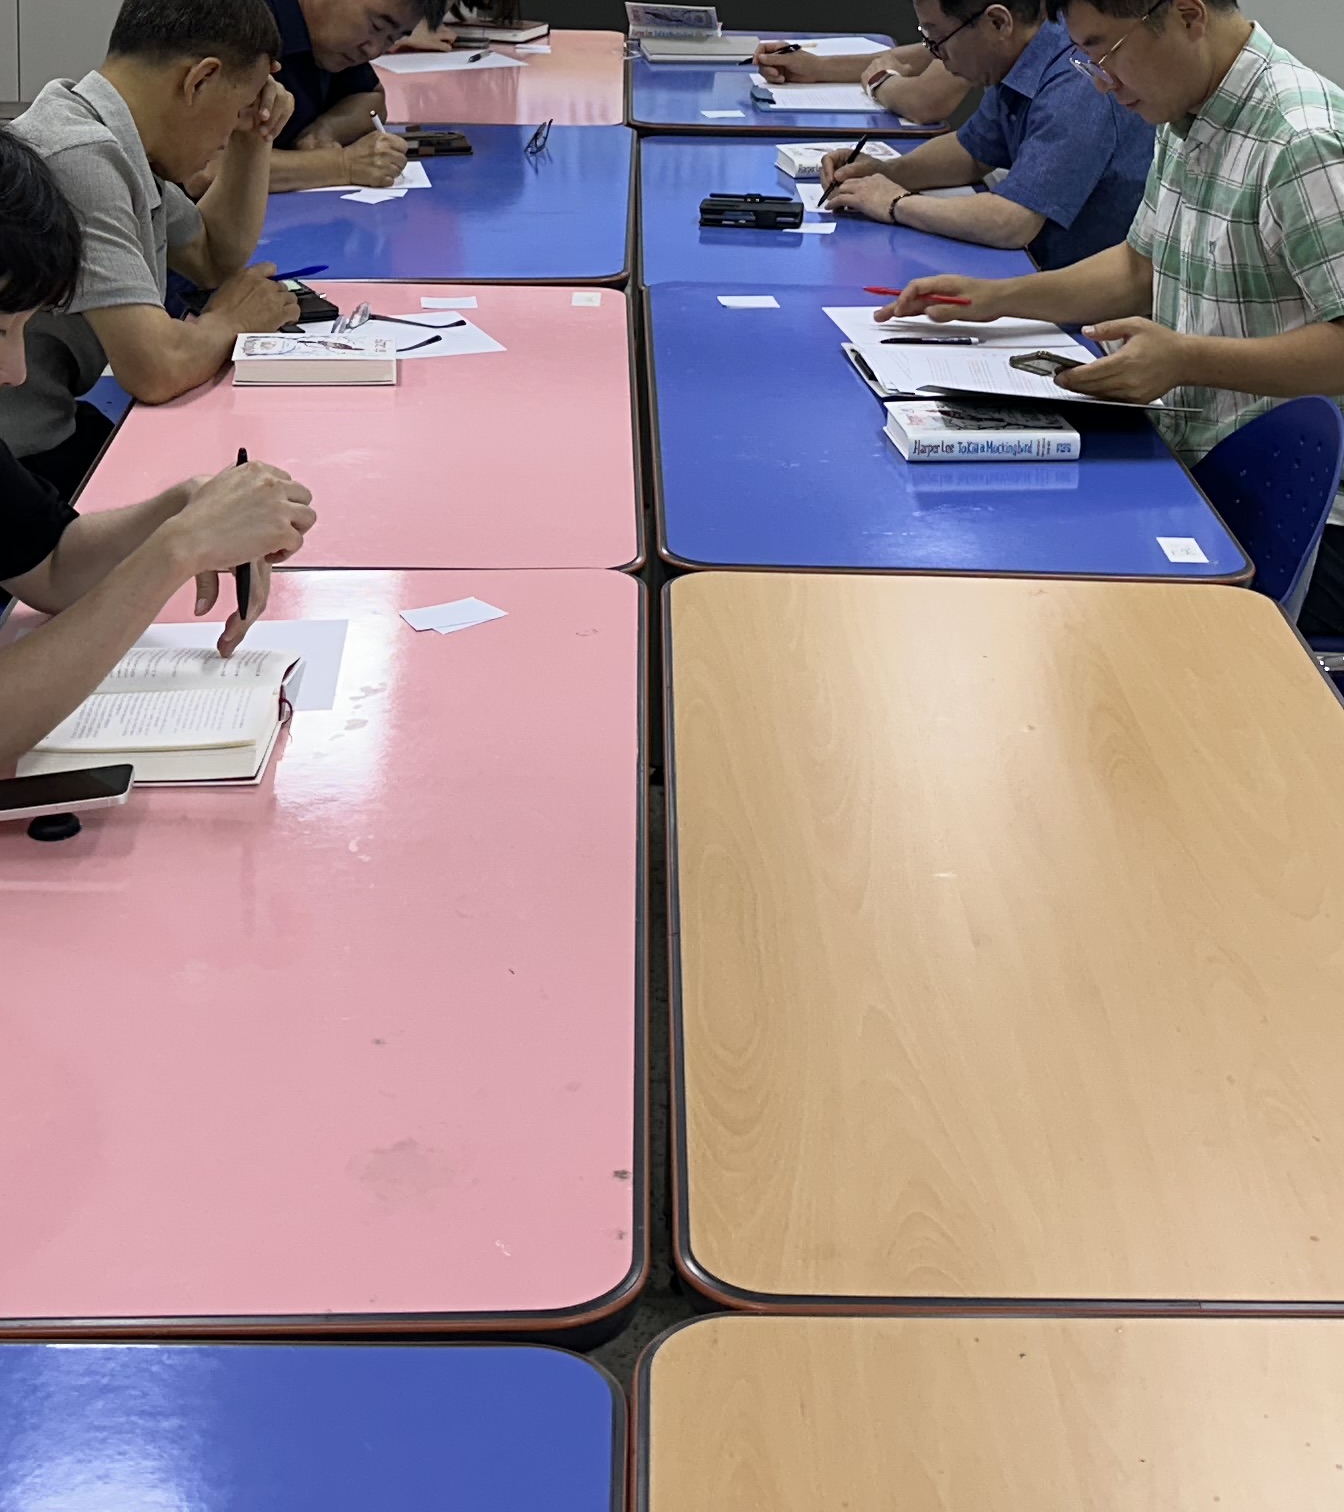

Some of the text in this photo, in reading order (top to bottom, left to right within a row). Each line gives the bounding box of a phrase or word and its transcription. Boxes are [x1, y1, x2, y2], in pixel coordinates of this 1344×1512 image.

[912, 440, 941, 457] Harper
[941, 440, 955, 454] Lee
[986, 440, 1033, 456] Mockingbird
